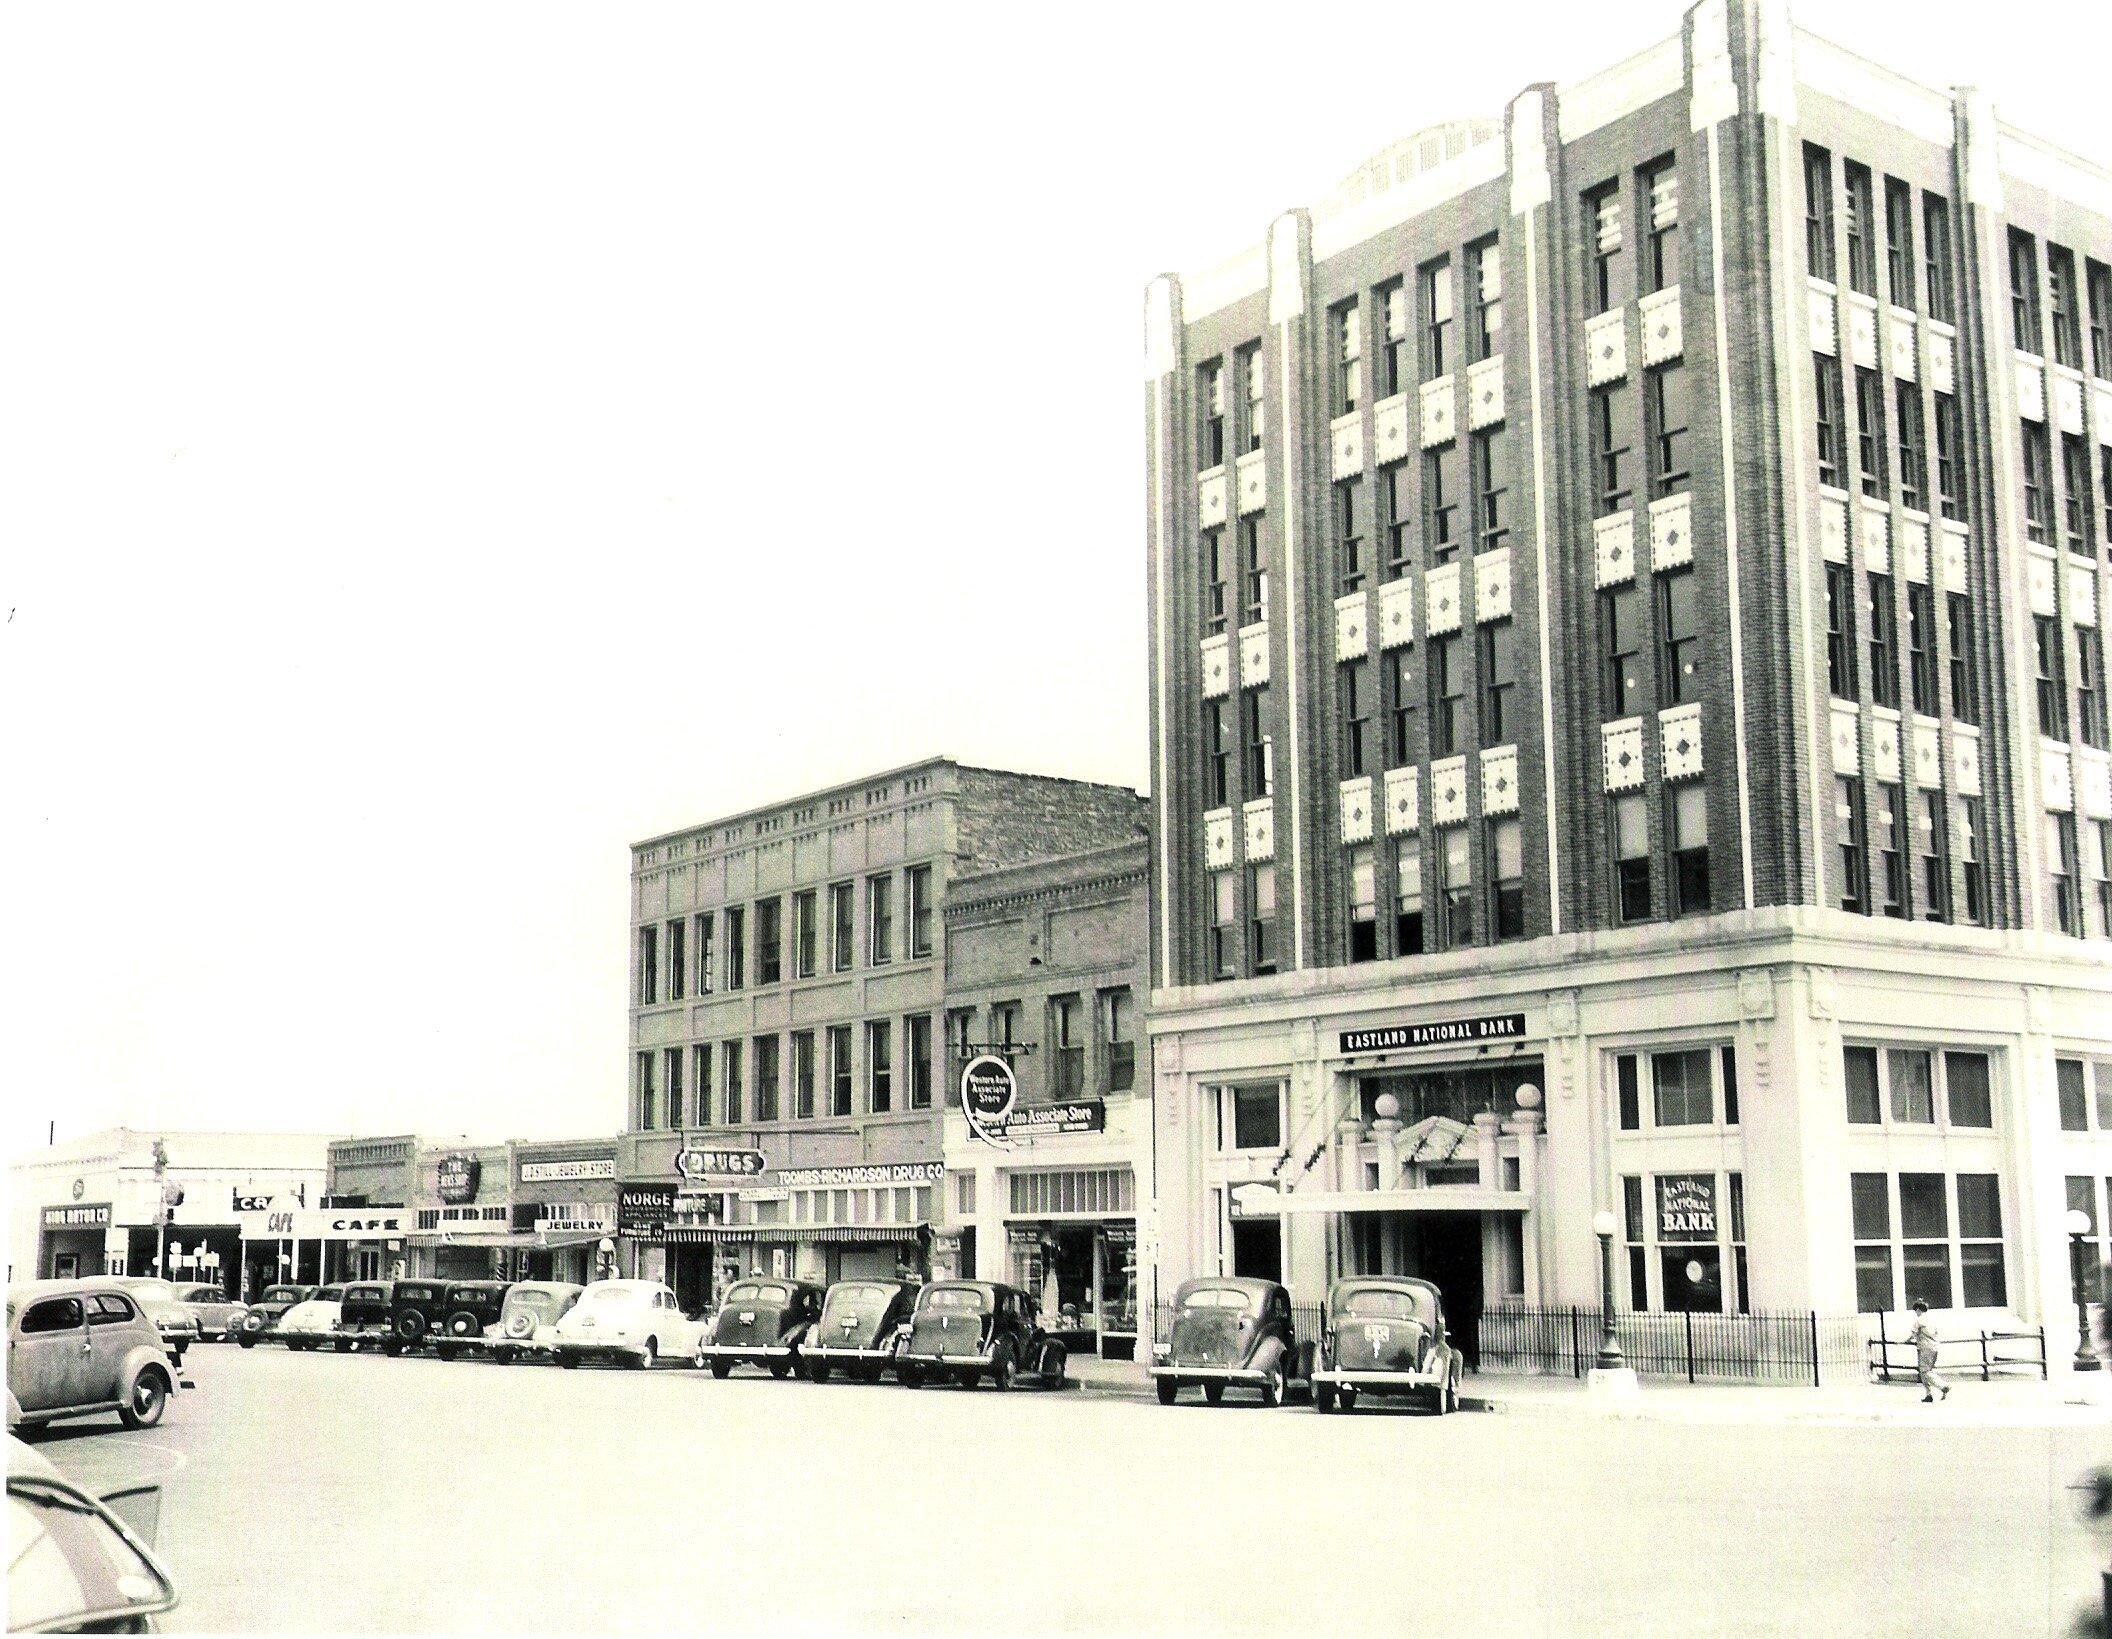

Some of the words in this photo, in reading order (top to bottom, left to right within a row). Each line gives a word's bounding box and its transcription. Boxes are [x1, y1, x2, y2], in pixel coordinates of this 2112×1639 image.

[1347, 1032, 1407, 1049] EASTLAND
[1413, 1024, 1471, 1042] NATIONAL
[1480, 1019, 1515, 1036] BANK
[979, 1094, 1000, 1104] Store
[1007, 1110, 1027, 1125] Auto
[1028, 1107, 1068, 1123] Associate
[1069, 1106, 1092, 1121] Store
[689, 1153, 754, 1172] DRUGS
[894, 1164, 924, 1182] DRUG
[240, 1197, 268, 1210] CA
[623, 1192, 671, 1206] NORGE
[332, 1219, 400, 1231] CAFE
[547, 1221, 603, 1230] JEWELRY
[1662, 1213, 1715, 1231] BANK
